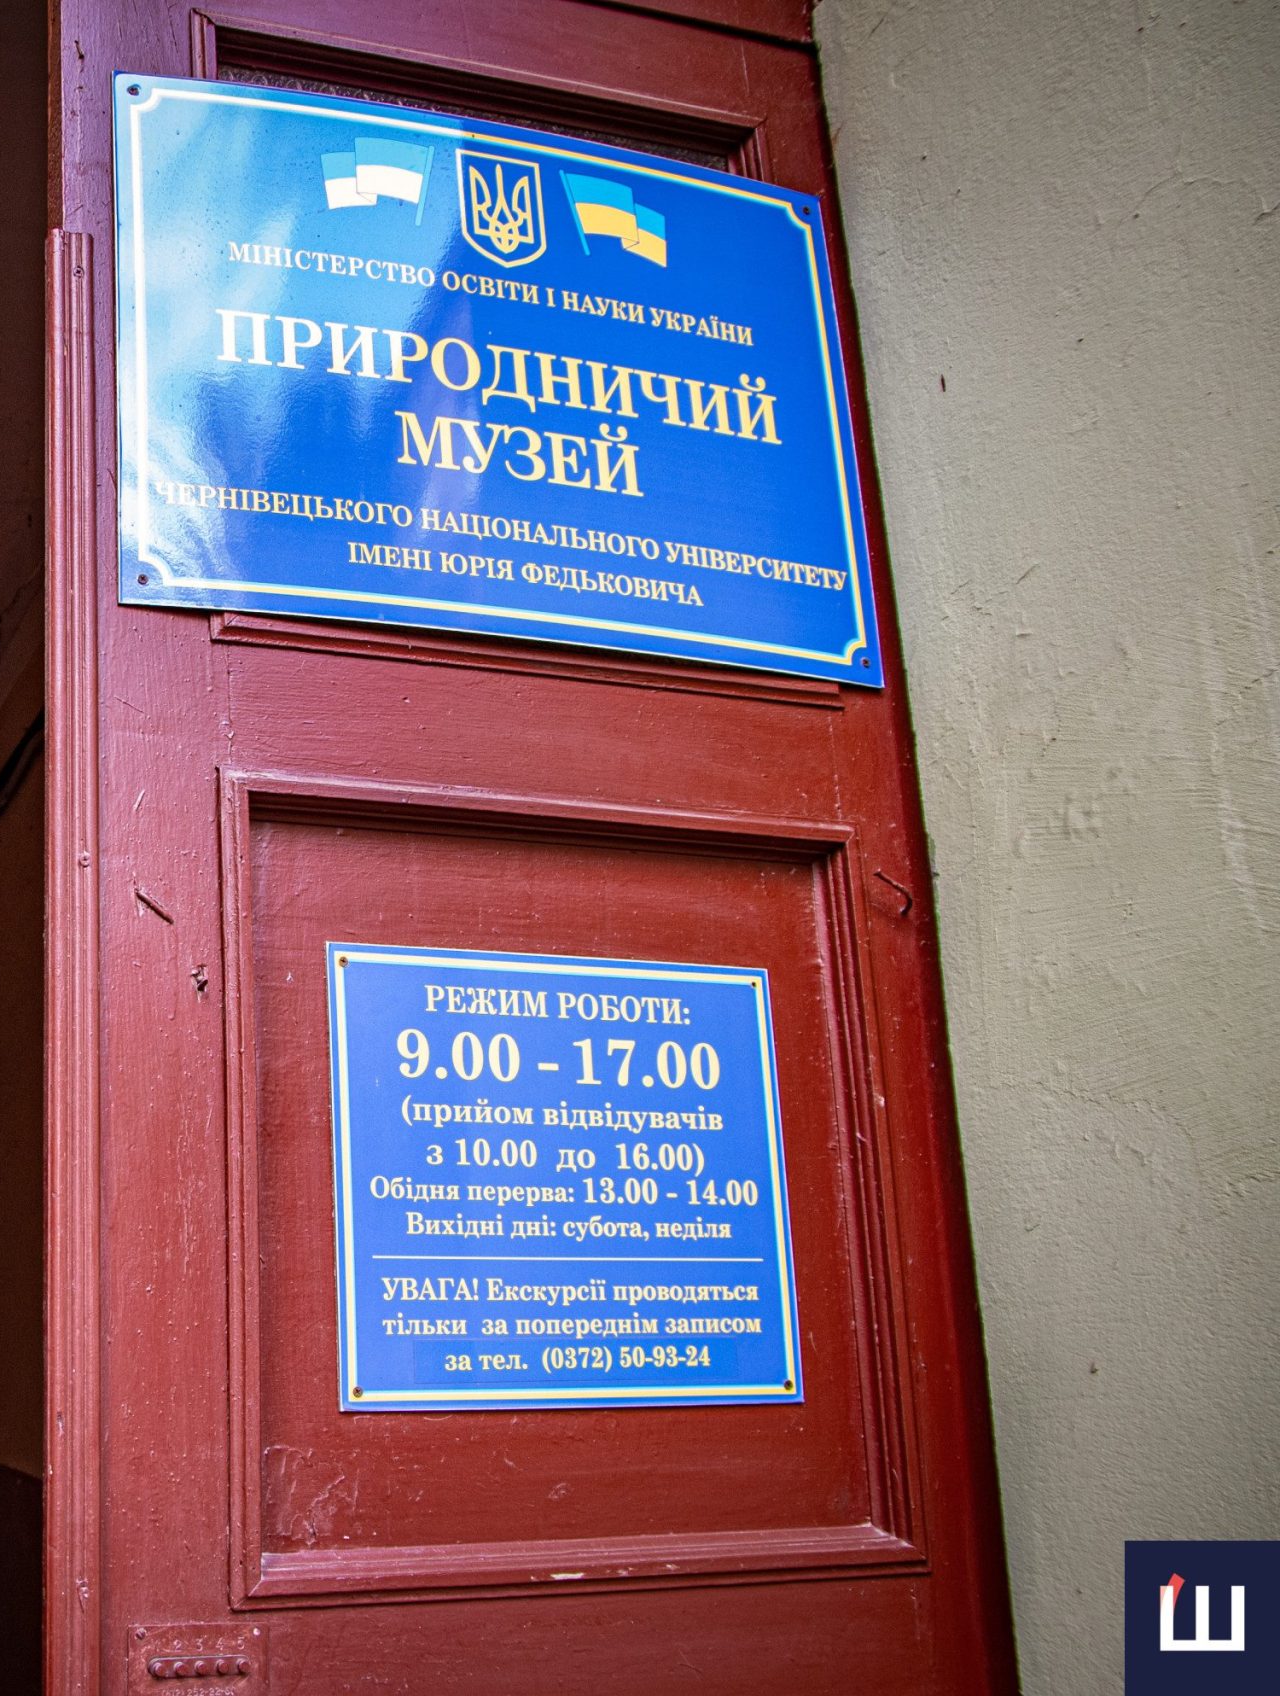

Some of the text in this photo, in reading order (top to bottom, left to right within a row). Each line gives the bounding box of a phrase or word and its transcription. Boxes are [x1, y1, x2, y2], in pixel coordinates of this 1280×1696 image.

[228, 241, 755, 347] МІНІСТЕРСТВО ОСВІТИ І НАУКИ УКРАЇНИ
[215, 308, 782, 445] ПРИРОДНИЧИЙ
[395, 410, 644, 498] МУЗЕЙ
[156, 482, 847, 592] ЧЕРНІВЕЦЬКОГО НАЦІОНАЛЬНОГО УНІВЕРСИТЕТУ
[348, 542, 704, 606] ІМЕНІ ЮРІЯ ФЕДЬКОВИЧА
[425, 984, 691, 1025] РЕЖИМ РОБОТИ:
[395, 1028, 521, 1083] 9.00
[572, 1037, 721, 1090] 17.00
[401, 1095, 724, 1134] (прийом відвідувачів
[426, 1139, 705, 1176] з 10.00 до 16.00)
[369, 1176, 460, 1202] Обідня
[467, 1184, 574, 1205] перерва:
[583, 1177, 659, 1205] 13.00
[686, 1179, 759, 1207] 14.00
[406, 1212, 732, 1241] Вихідні дні: субота, неділя
[382, 1277, 759, 1305] УВАГА! Екскурсії проводяться
[382, 1312, 762, 1338] тільки за попереднім записом
[444, 1344, 711, 1373] за тел. (0372) 50-93-24
